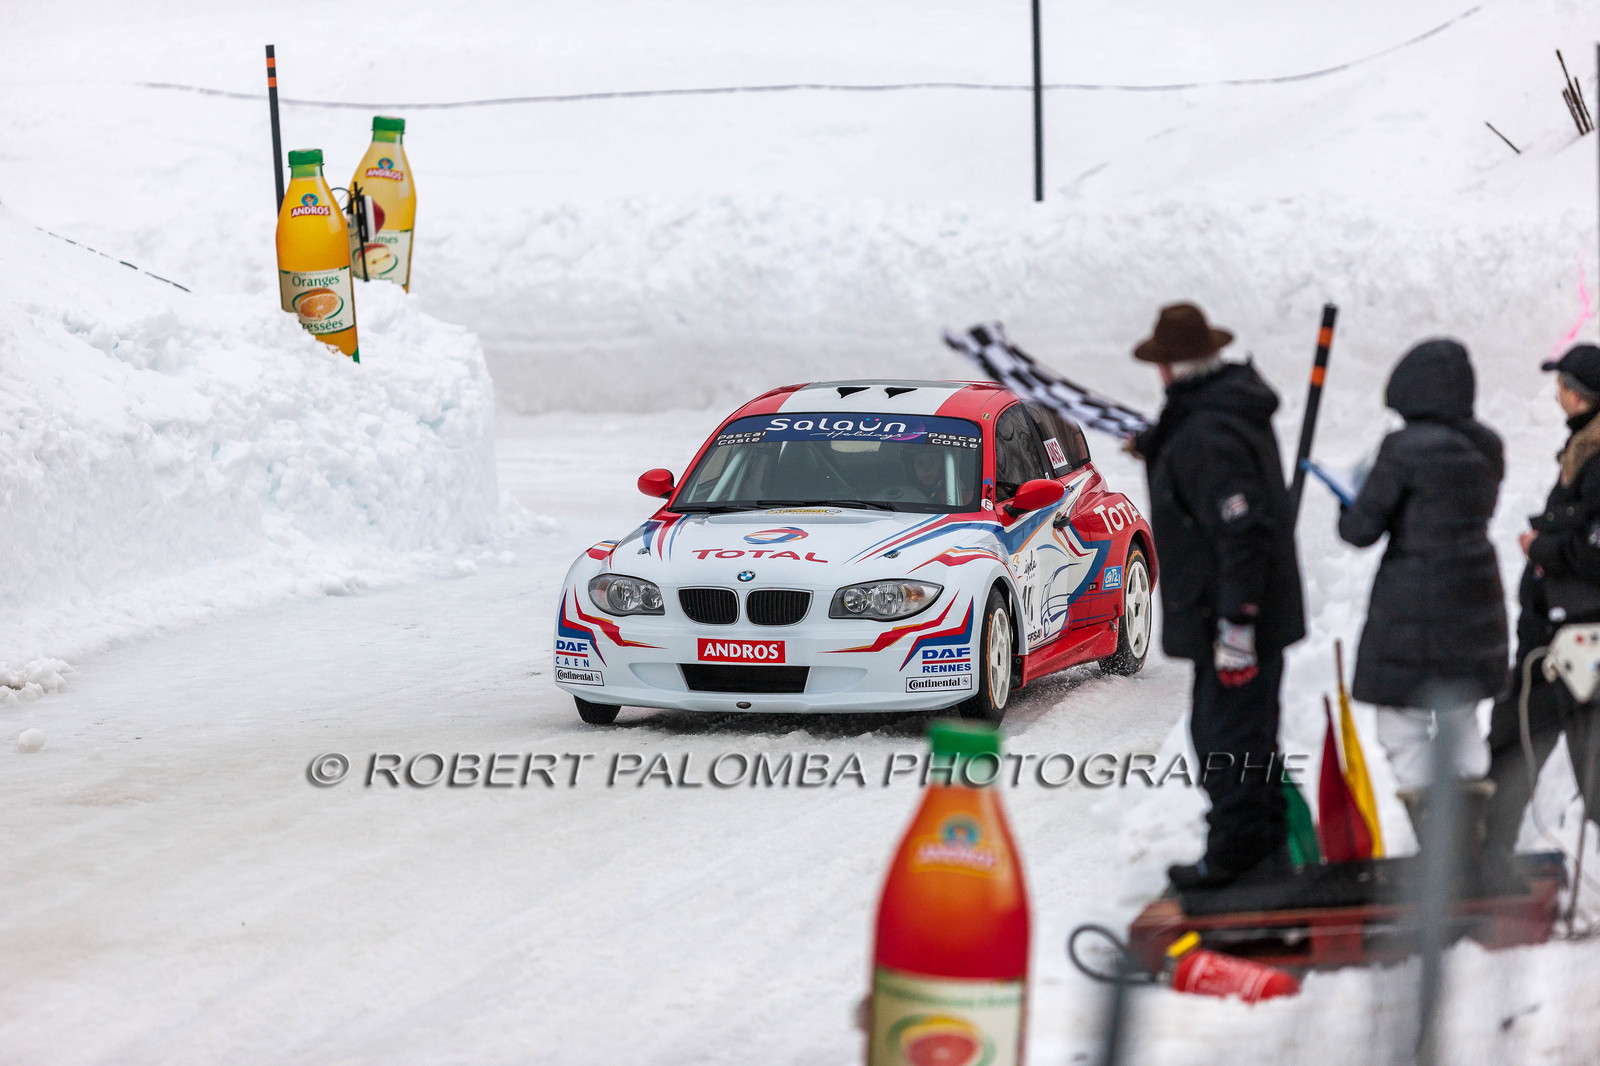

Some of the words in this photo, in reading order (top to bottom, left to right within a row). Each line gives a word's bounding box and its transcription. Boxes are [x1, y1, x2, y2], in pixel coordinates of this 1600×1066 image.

[366, 168, 403, 180] ANDROS
[291, 206, 330, 217] ANDROS
[292, 274, 340, 288] Oranges
[301, 319, 344, 332] ressées
[717, 431, 766, 441] Pascal
[718, 437, 760, 446] Coste
[928, 432, 982, 443] Pascal
[932, 438, 978, 449] Coste
[1093, 500, 1143, 534] TOTA
[692, 548, 829, 563] TOTAL
[556, 640, 588, 652] DAF
[703, 642, 779, 660] ANDROS
[922, 647, 971, 659] DAF
[922, 663, 972, 673] RENNES
[557, 669, 594, 681] Continental
[908, 677, 961, 690] Continental
